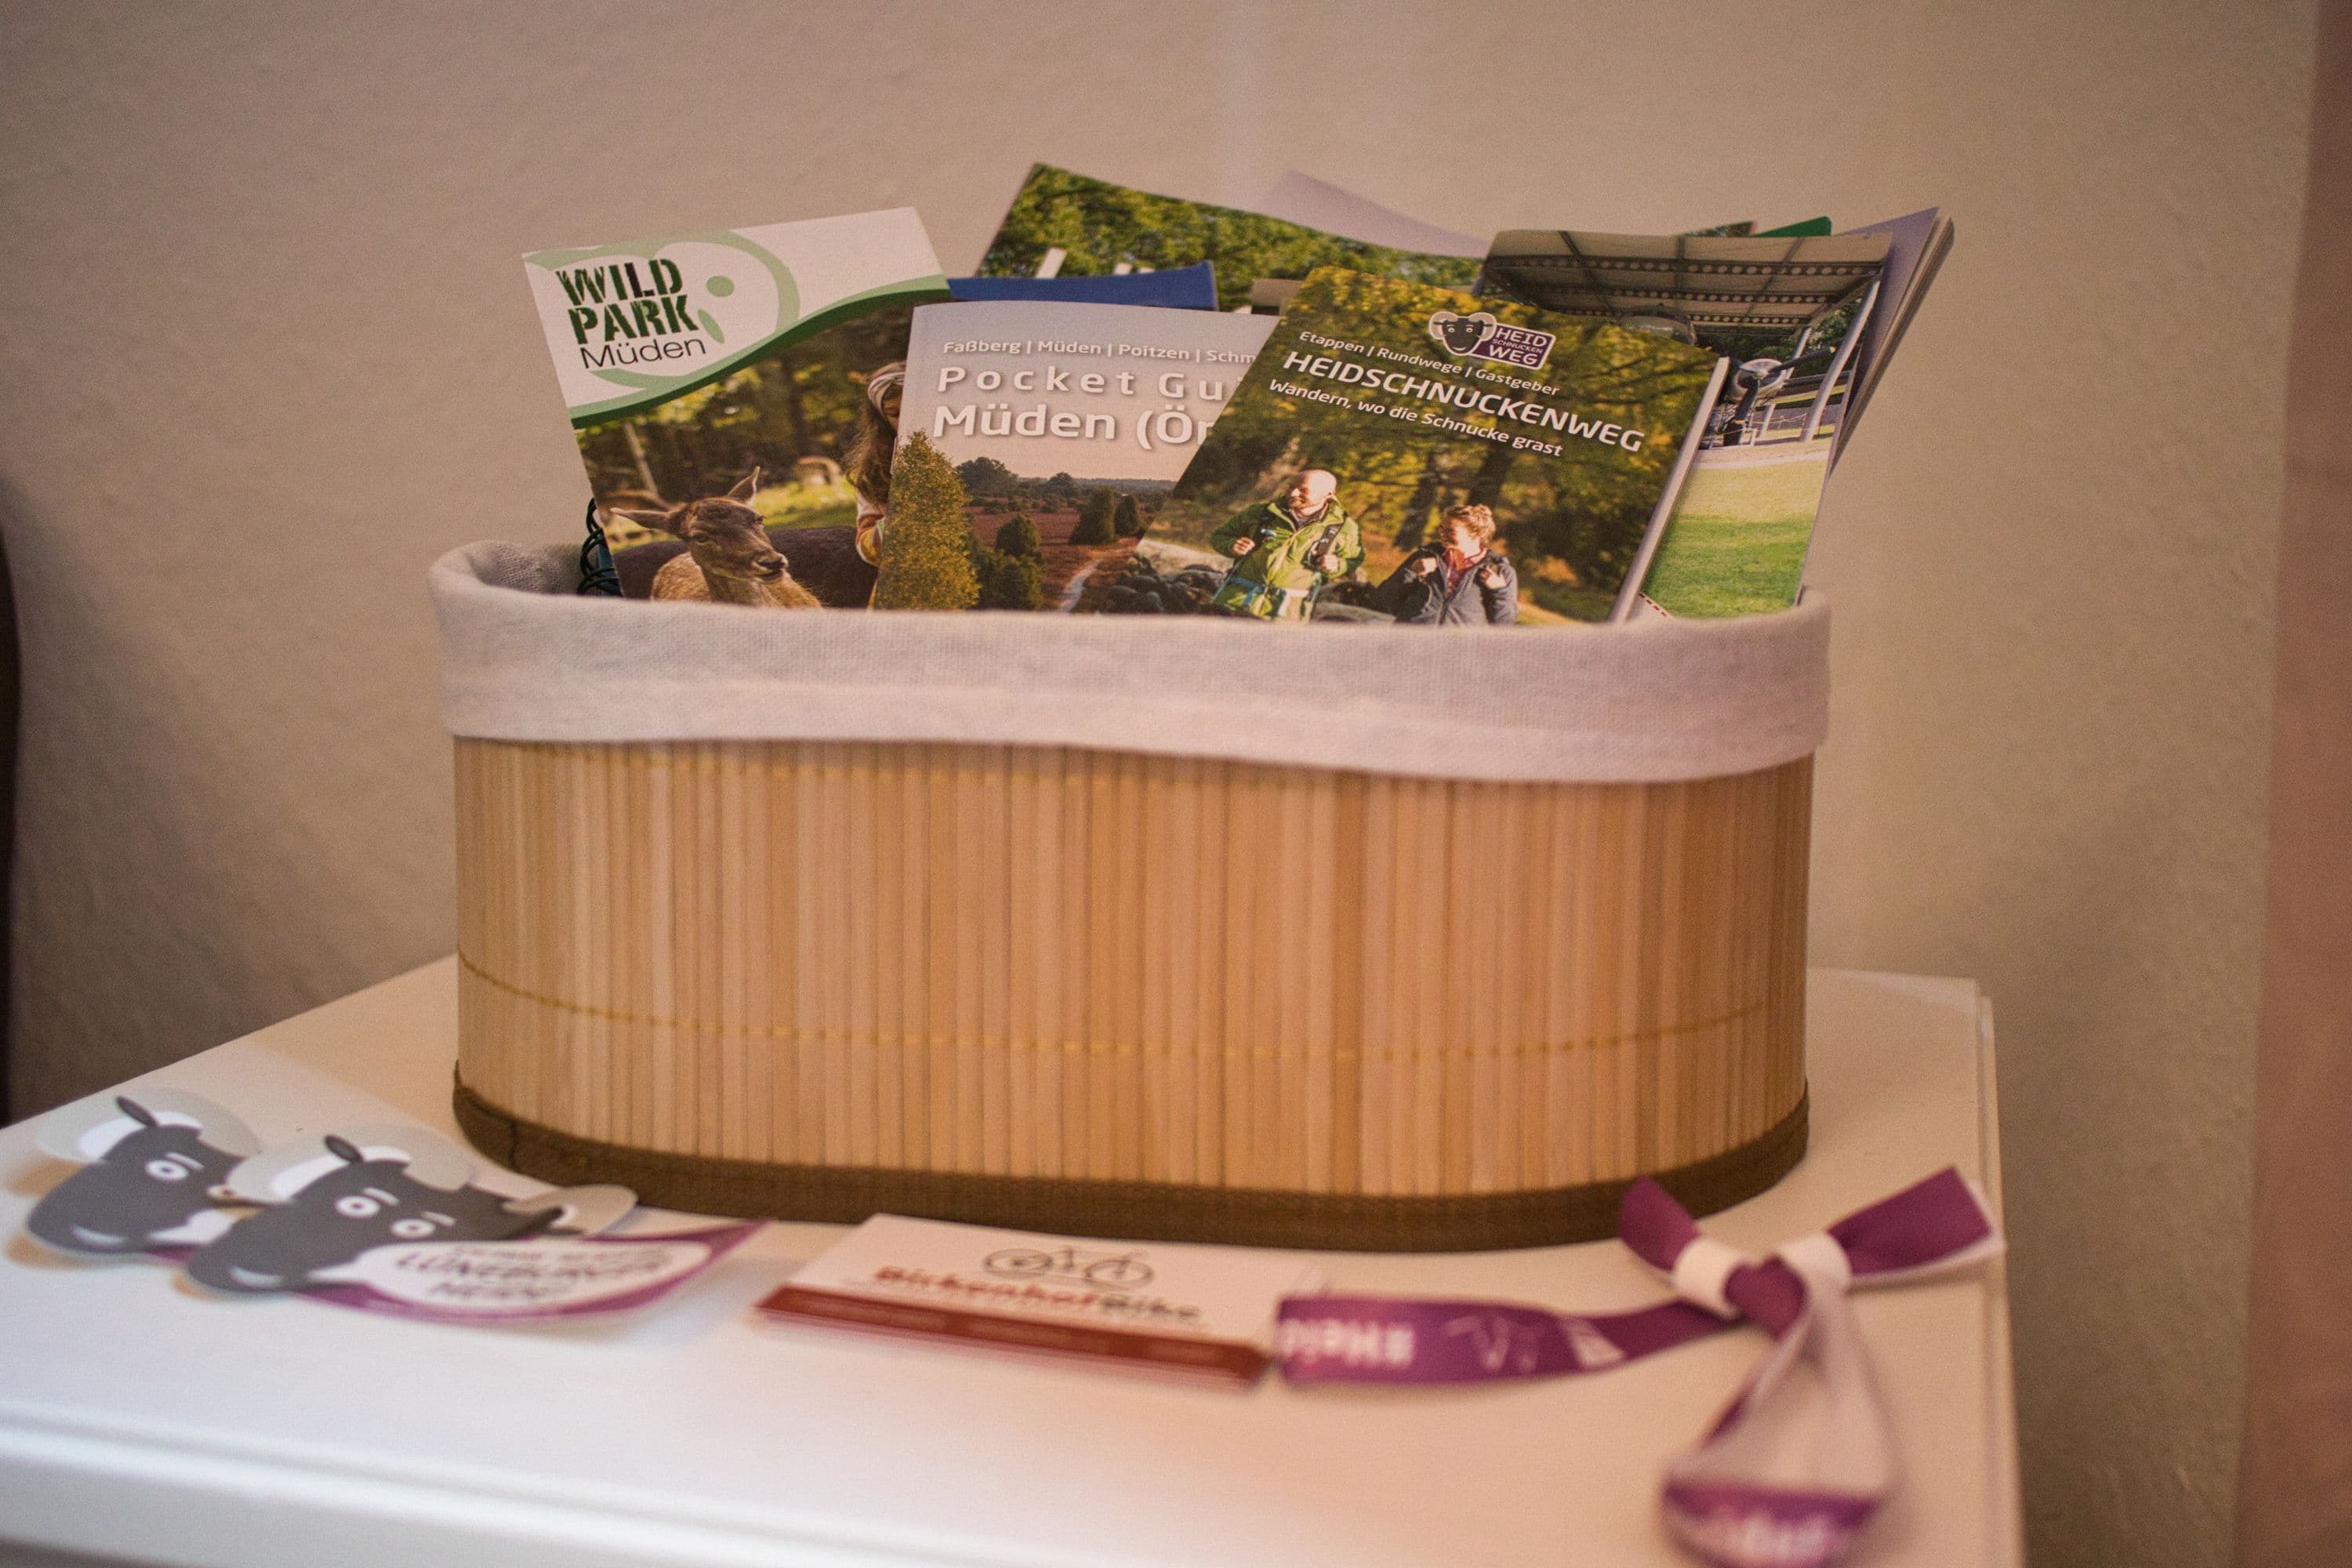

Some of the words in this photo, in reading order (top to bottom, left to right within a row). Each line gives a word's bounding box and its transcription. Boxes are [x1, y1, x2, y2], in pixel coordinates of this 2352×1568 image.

[555, 259, 682, 306] WILD
[568, 295, 699, 344] PARK
[1496, 327, 1548, 347] HEID
[580, 339, 706, 368] Müden
[943, 340, 1021, 354] Faßberg
[1037, 340, 1102, 354] Müden
[1119, 344, 1189, 360] Poitzen
[1299, 331, 1364, 353] Etappen
[1377, 347, 1462, 374] Rundwege
[1475, 368, 1559, 395] Gastgeber
[1490, 344, 1538, 365] WEG
[1492, 338, 1543, 354] SCHNUCKEN
[938, 365, 1134, 395] Pocket
[1159, 372, 1243, 401] Gu
[1283, 350, 1645, 452] HEIDSCHNUCKENWEG
[933, 403, 1116, 439] Müden
[1269, 379, 1352, 409] Wandern,
[1358, 401, 1385, 415] wo
[1389, 406, 1417, 422] die
[1421, 412, 1509, 443] Schnucke
[1512, 436, 1563, 457] grast
